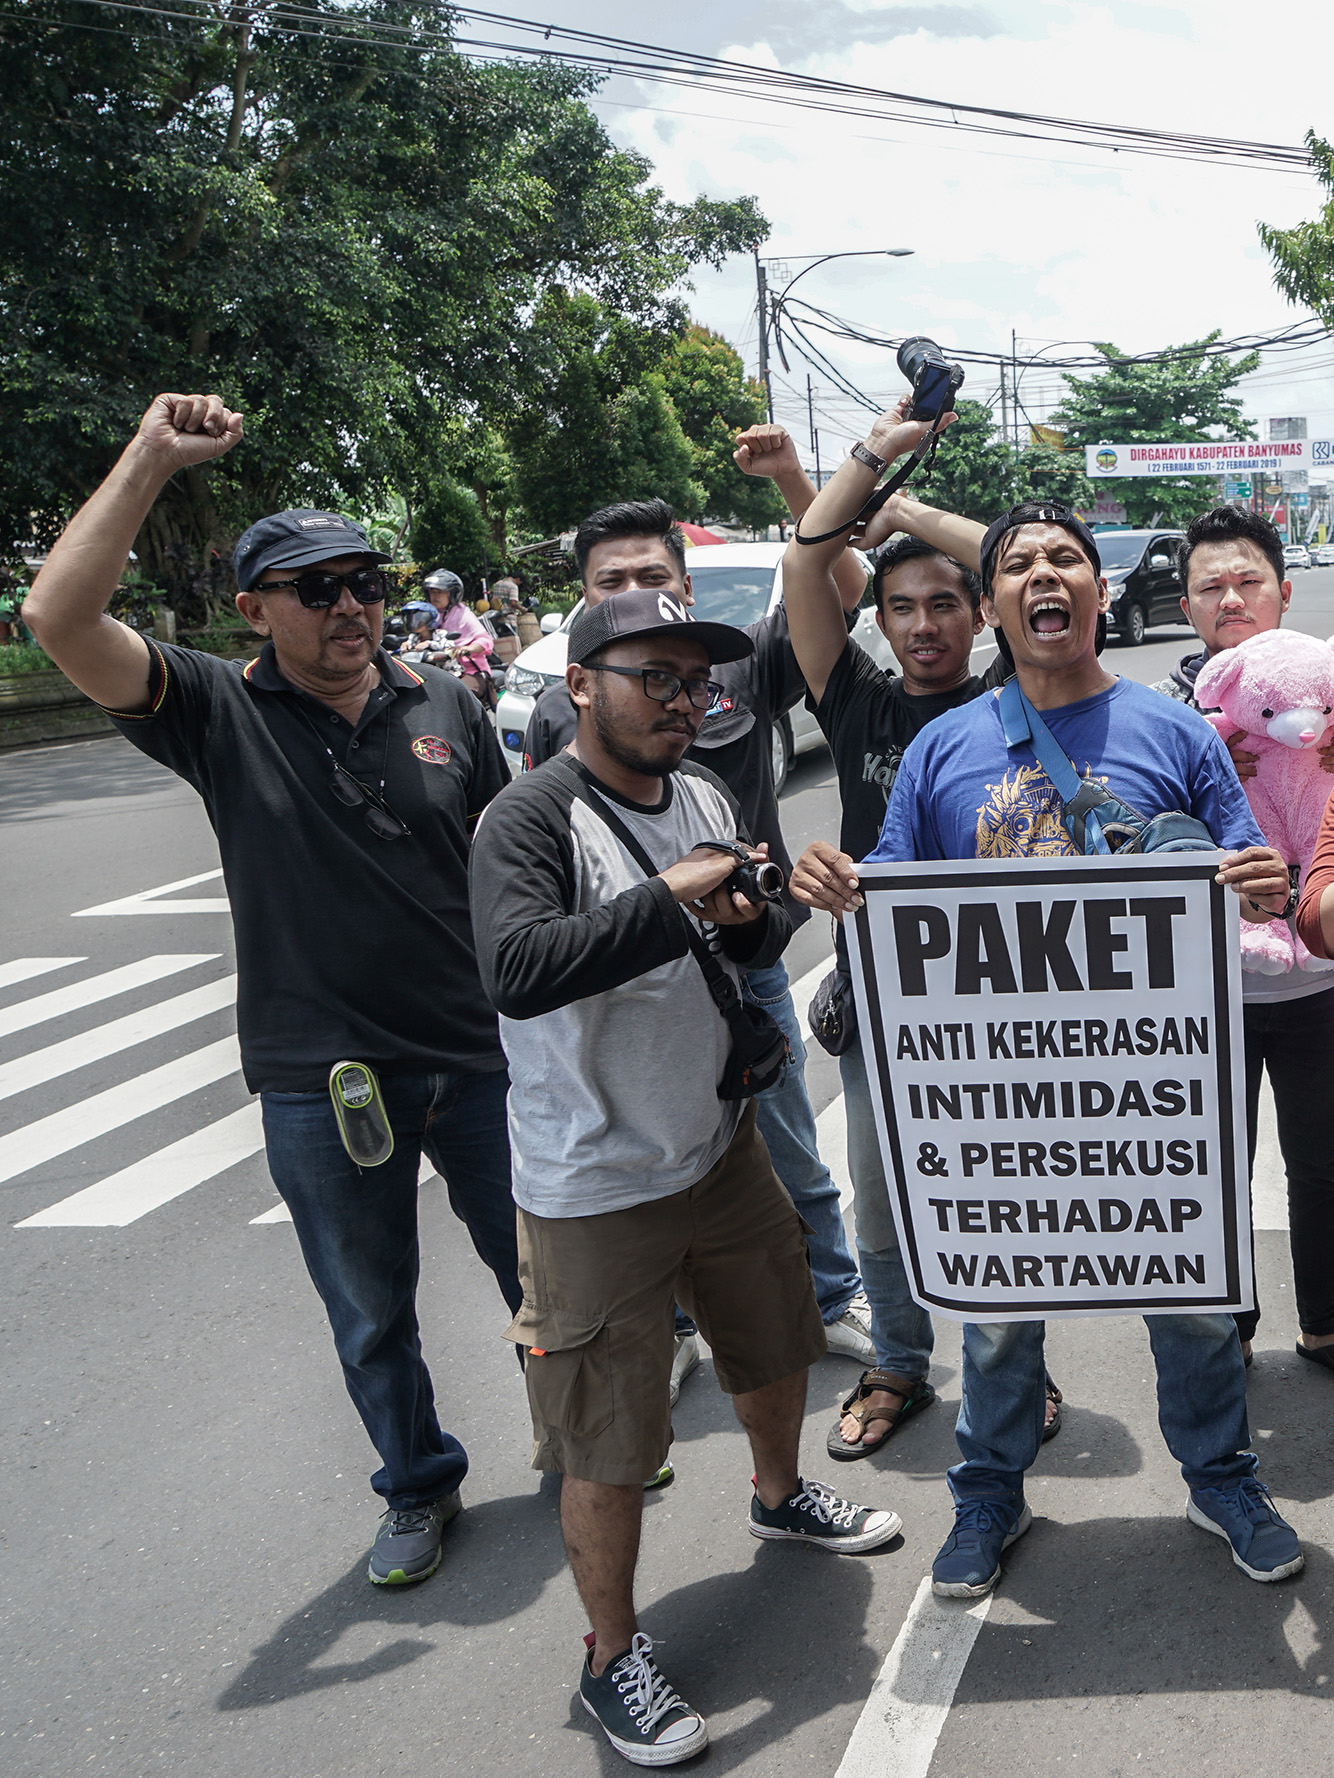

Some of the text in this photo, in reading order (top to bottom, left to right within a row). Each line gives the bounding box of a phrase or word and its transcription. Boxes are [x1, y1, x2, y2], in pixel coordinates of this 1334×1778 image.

[1130, 443, 1303, 461] DIRGAHAYU KABUPATEN BANYUMAS
[1162, 463, 1195, 472] FEBRUARI
[1197, 462, 1211, 471] 1571
[1226, 460, 1259, 470] FEBRUARI
[892, 896, 1187, 996] PAKET
[897, 1016, 1210, 1061] ANTI KEKERASAN
[908, 1079, 1204, 1120] INTIMIDASI
[916, 1139, 1208, 1178] & PERSEKUSI
[928, 1198, 1202, 1234] TERHADAP
[937, 1252, 1206, 1287] WARTAWAN
